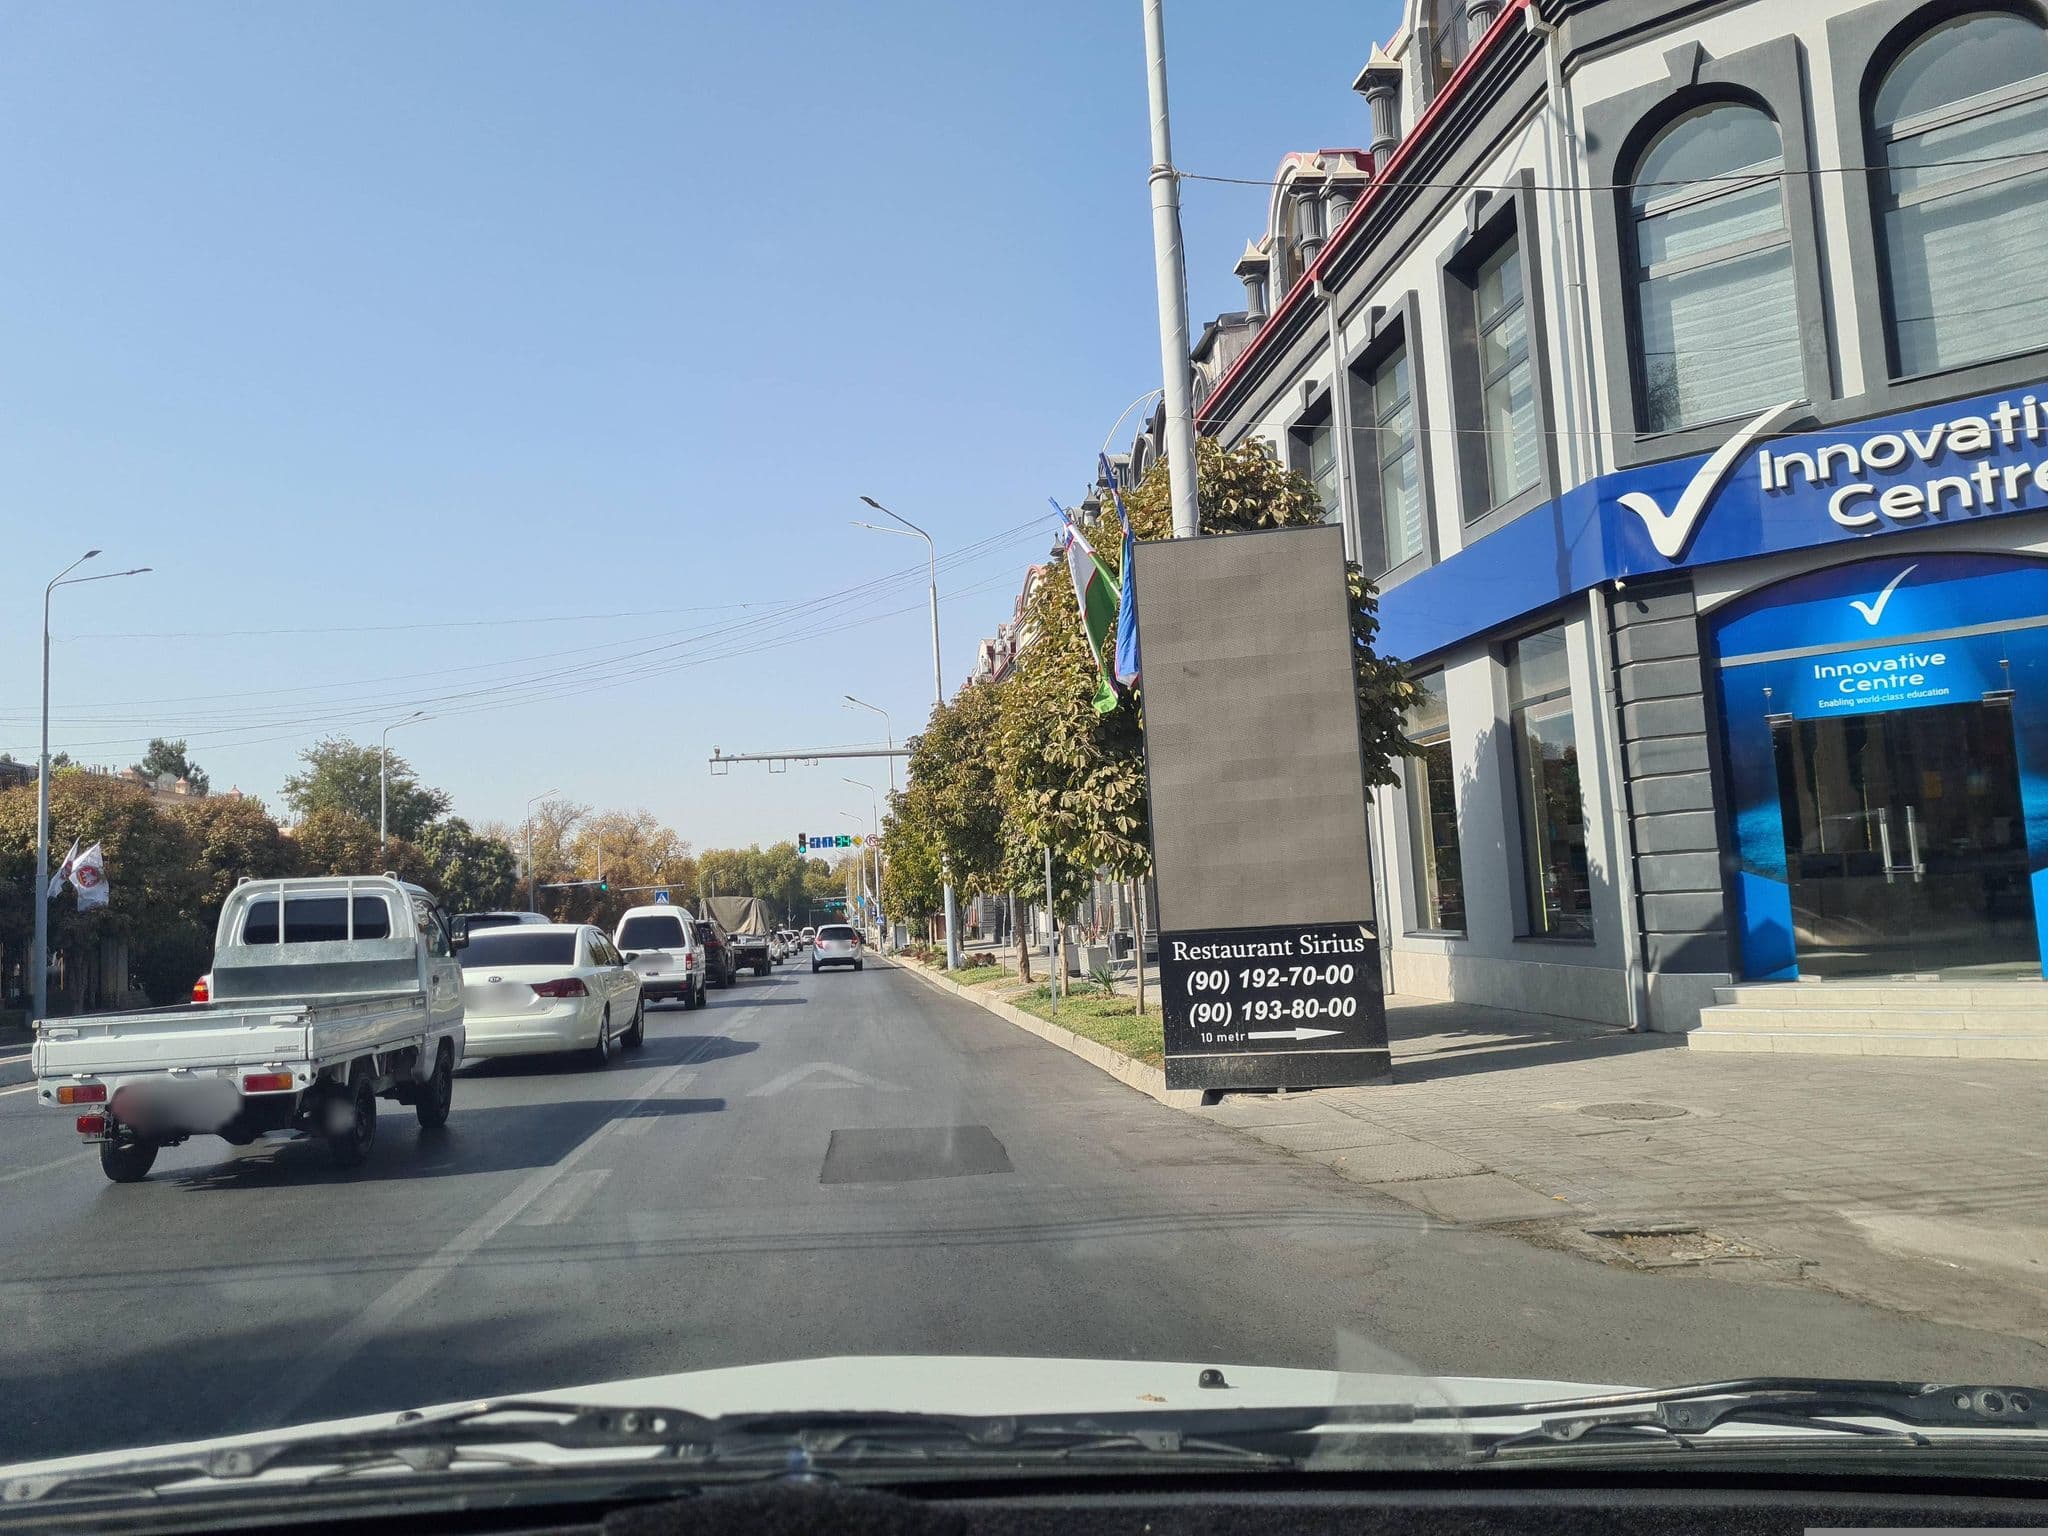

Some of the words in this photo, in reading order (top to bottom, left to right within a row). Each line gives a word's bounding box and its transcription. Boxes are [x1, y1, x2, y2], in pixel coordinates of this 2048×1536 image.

[1757, 395, 2048, 491] Innovati
[1814, 652, 1946, 679] Innovative
[1839, 673, 1925, 693] Centre
[1818, 697, 1855, 709] Enabling
[1856, 693, 1905, 705] world-class
[1906, 687, 1950, 699] education
[1172, 939, 1294, 961] Restaurant
[1299, 933, 1365, 955] Sirius
[1186, 970, 1231, 996] (90)
[1239, 964, 1354, 989] 192-70-00
[1189, 1002, 1233, 1028] (90)
[1241, 997, 1357, 1021] 193-80-00
[1200, 1032, 1213, 1043] 10
[1216, 1031, 1246, 1043] metr
